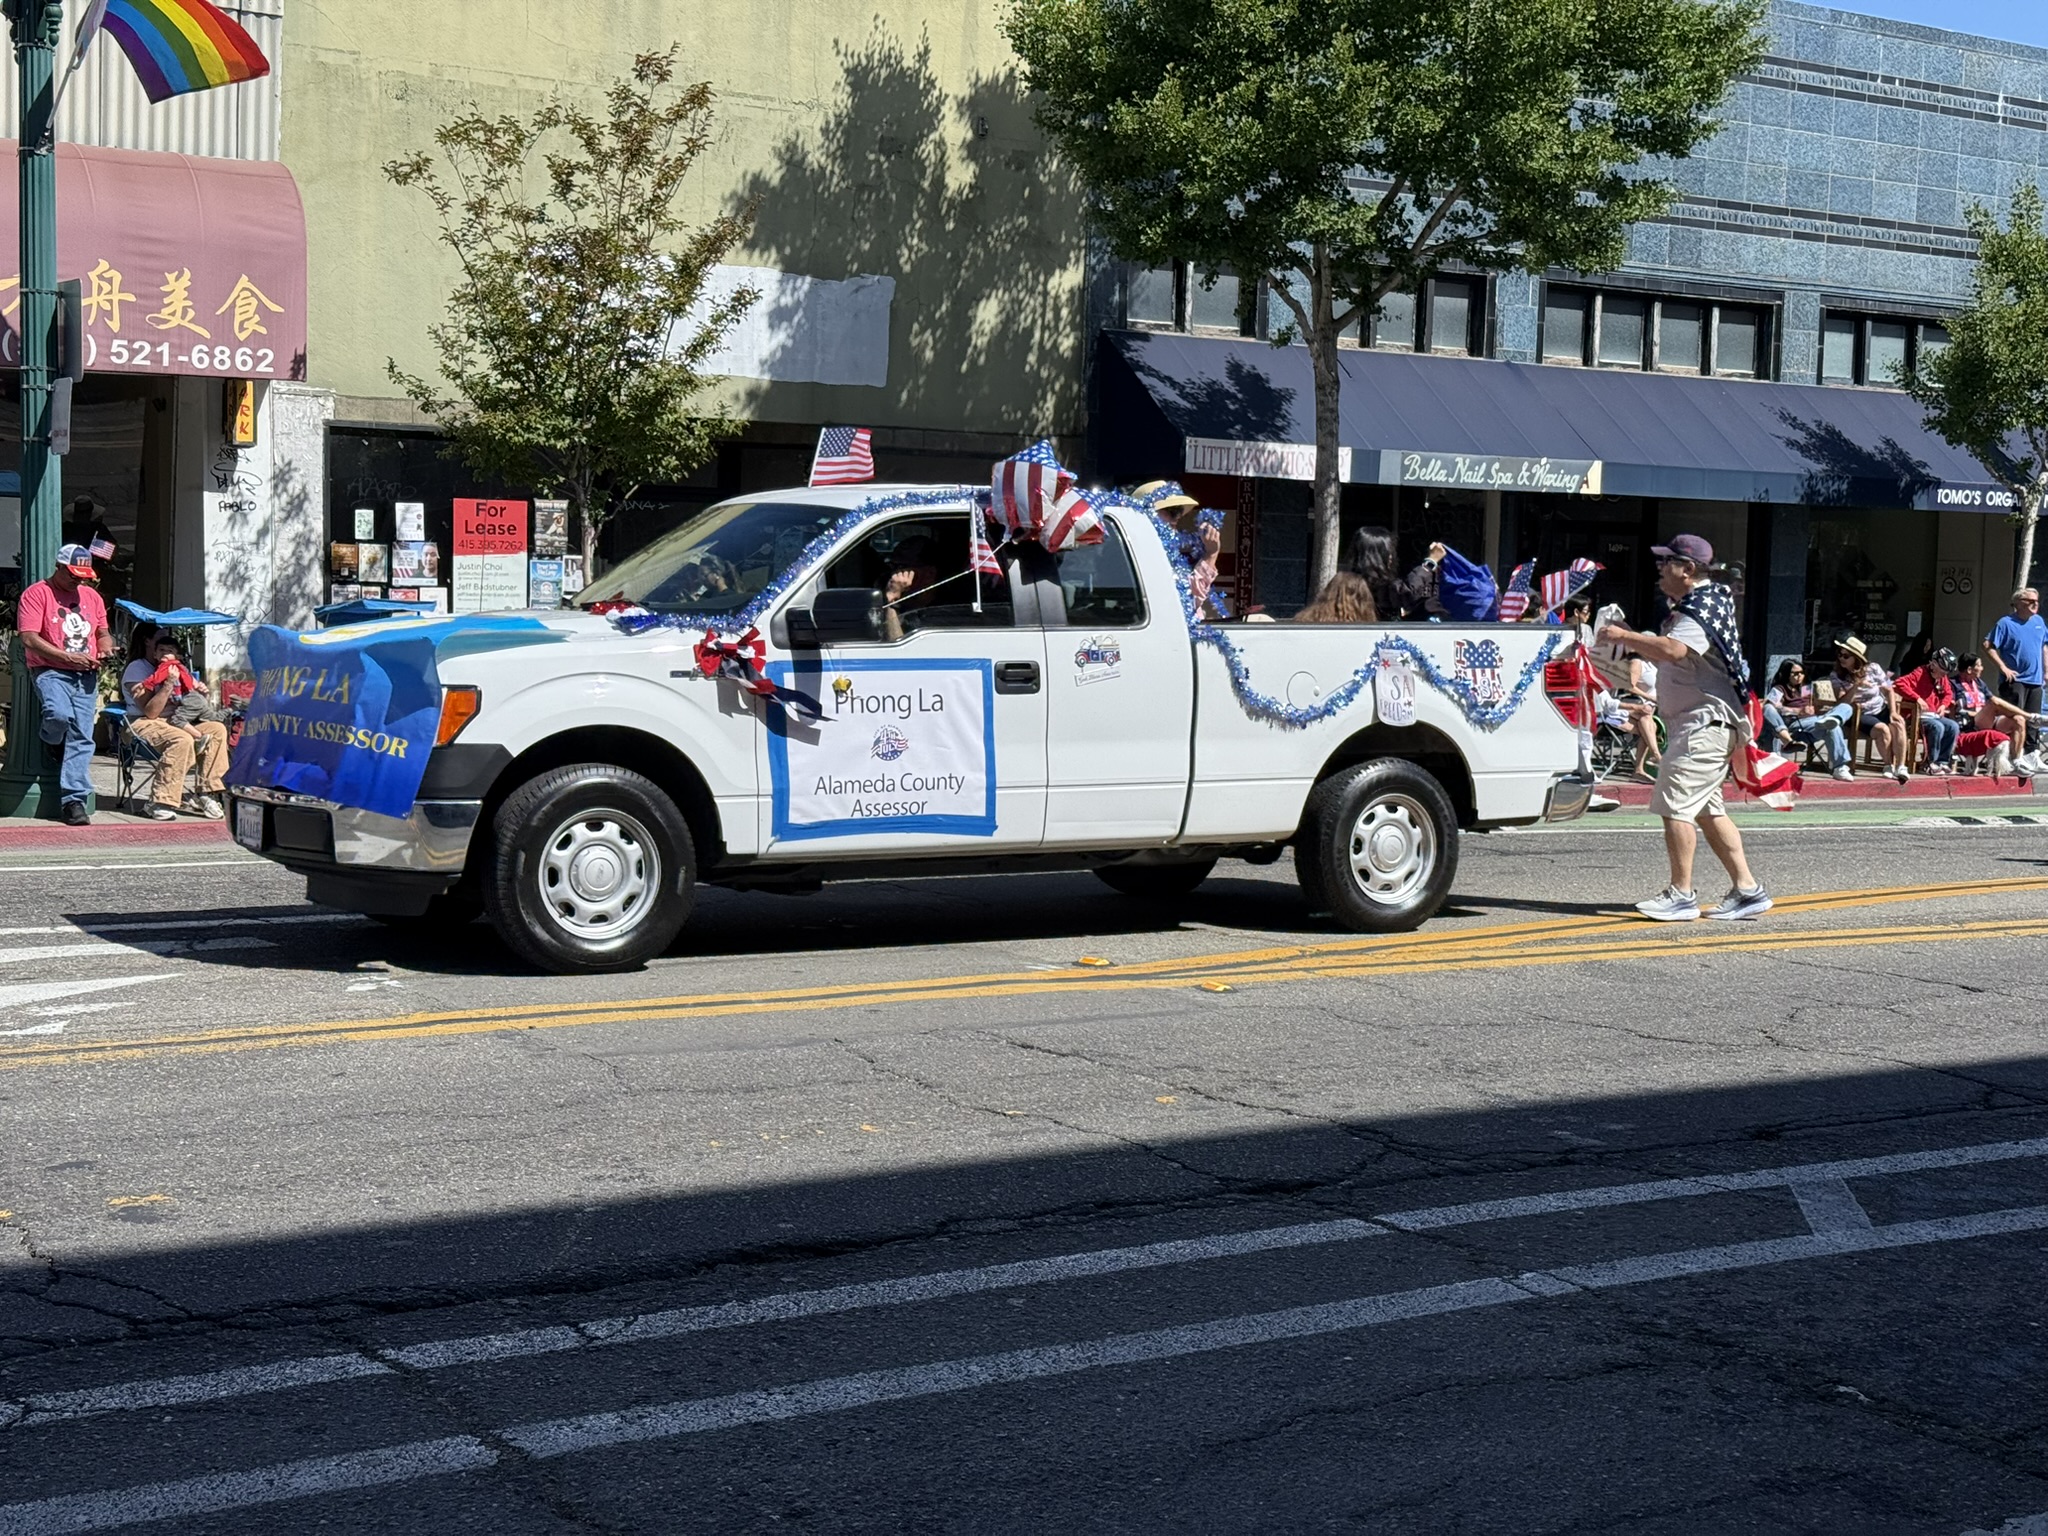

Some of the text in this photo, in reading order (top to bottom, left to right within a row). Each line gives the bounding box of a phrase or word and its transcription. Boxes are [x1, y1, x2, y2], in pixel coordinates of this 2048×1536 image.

[109, 338, 275, 373] 521-6862
[1193, 444, 1242, 472] LITTLE
[1403, 454, 1448, 481] Bella
[1449, 457, 1485, 485] Nail
[1487, 460, 1514, 489] Spa
[1517, 461, 1531, 486] &
[1531, 462, 1581, 493] Waxing
[475, 502, 507, 518] For
[1242, 475, 1253, 537] RTUNE
[1937, 488, 2021, 507] TOMO'S ORGA
[464, 519, 517, 536] Lease
[456, 562, 503, 571] Justin Choi
[456, 583, 472, 591] Jeff
[311, 668, 349, 705] LA
[834, 687, 945, 720] Phong La
[303, 720, 409, 760] ASSESSOR
[813, 772, 965, 796] Alameda County
[850, 799, 928, 818] Assessor
